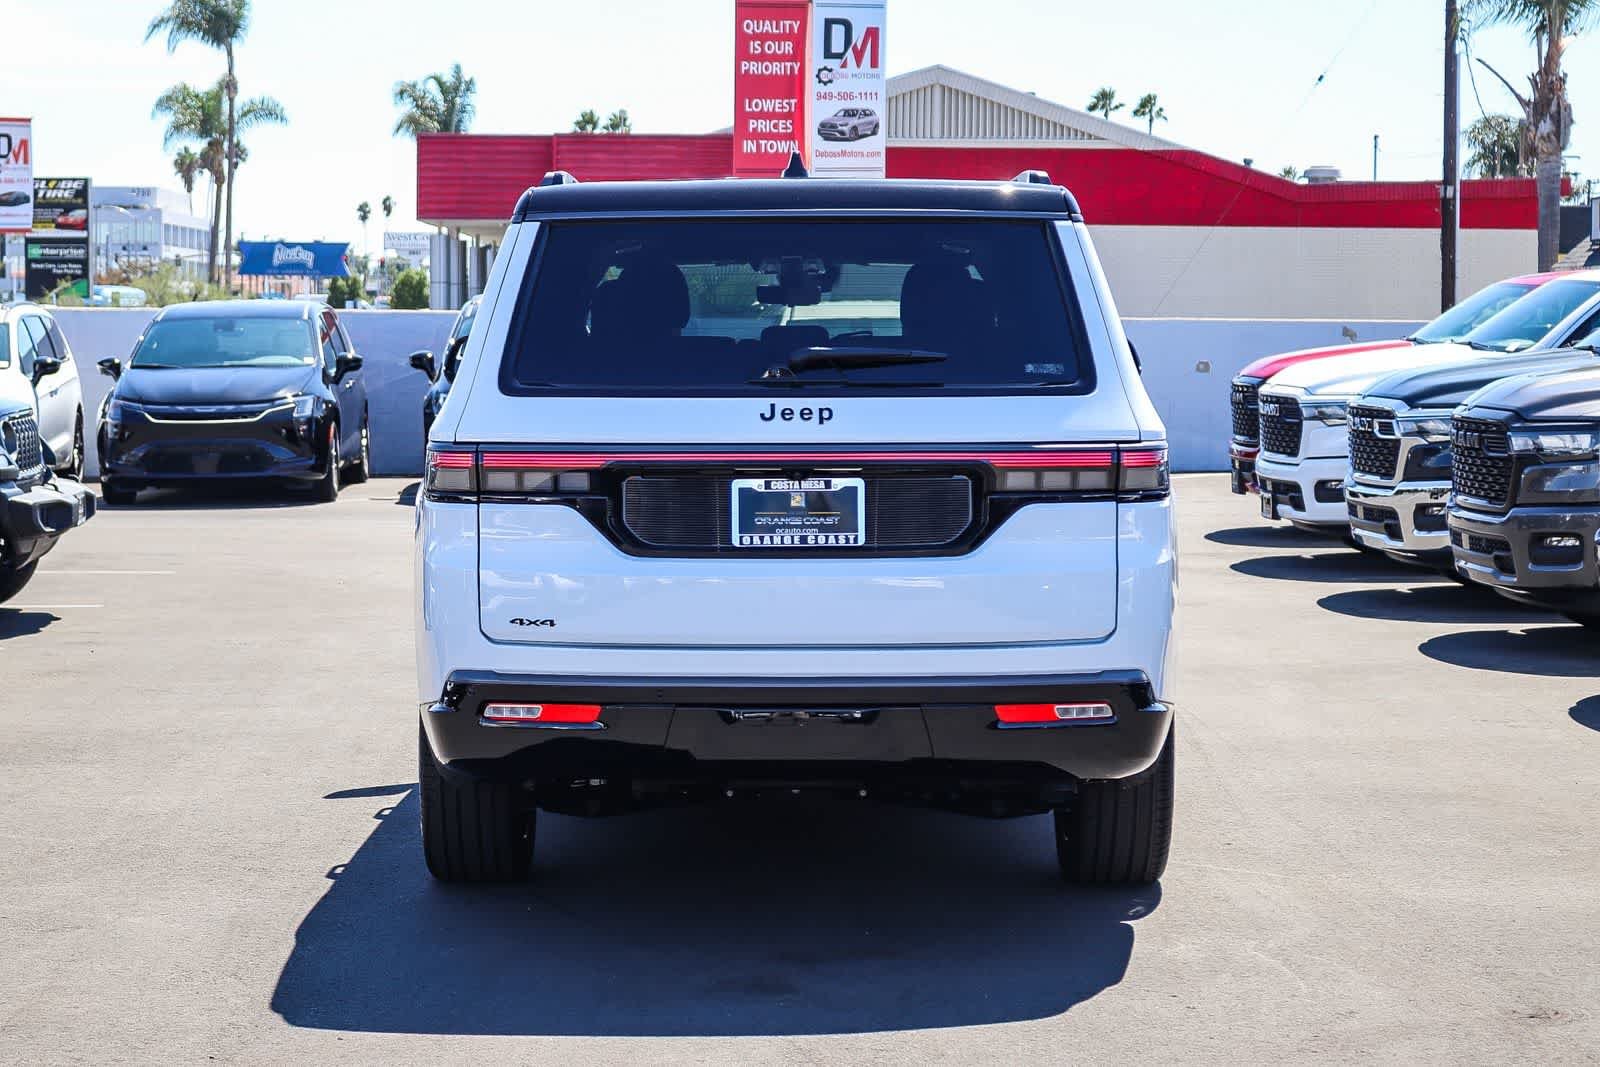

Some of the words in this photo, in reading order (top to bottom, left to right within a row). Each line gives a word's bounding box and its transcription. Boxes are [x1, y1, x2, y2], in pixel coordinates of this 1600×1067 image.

[743, 20, 800, 34] QUALITY
[750, 40, 761, 54] IS
[764, 41, 793, 54] OUR
[823, 17, 880, 69] DM
[741, 62, 800, 75] PRIORITY
[816, 91, 878, 101] 949-506-1111
[745, 99, 797, 112] LOWEST
[749, 120, 793, 133] PRICES
[743, 140, 756, 153] IN
[759, 140, 799, 153] TOWN
[31, 247, 85, 256] enterprise
[759, 403, 833, 425] Jeep
[770, 480, 800, 489] COSTA
[801, 480, 826, 489] MESA
[755, 516, 803, 525] ORANGE
[803, 516, 840, 525] COAST
[776, 527, 819, 535] ocauto.com
[742, 535, 800, 545] ORANGE
[807, 535, 856, 544] COAST
